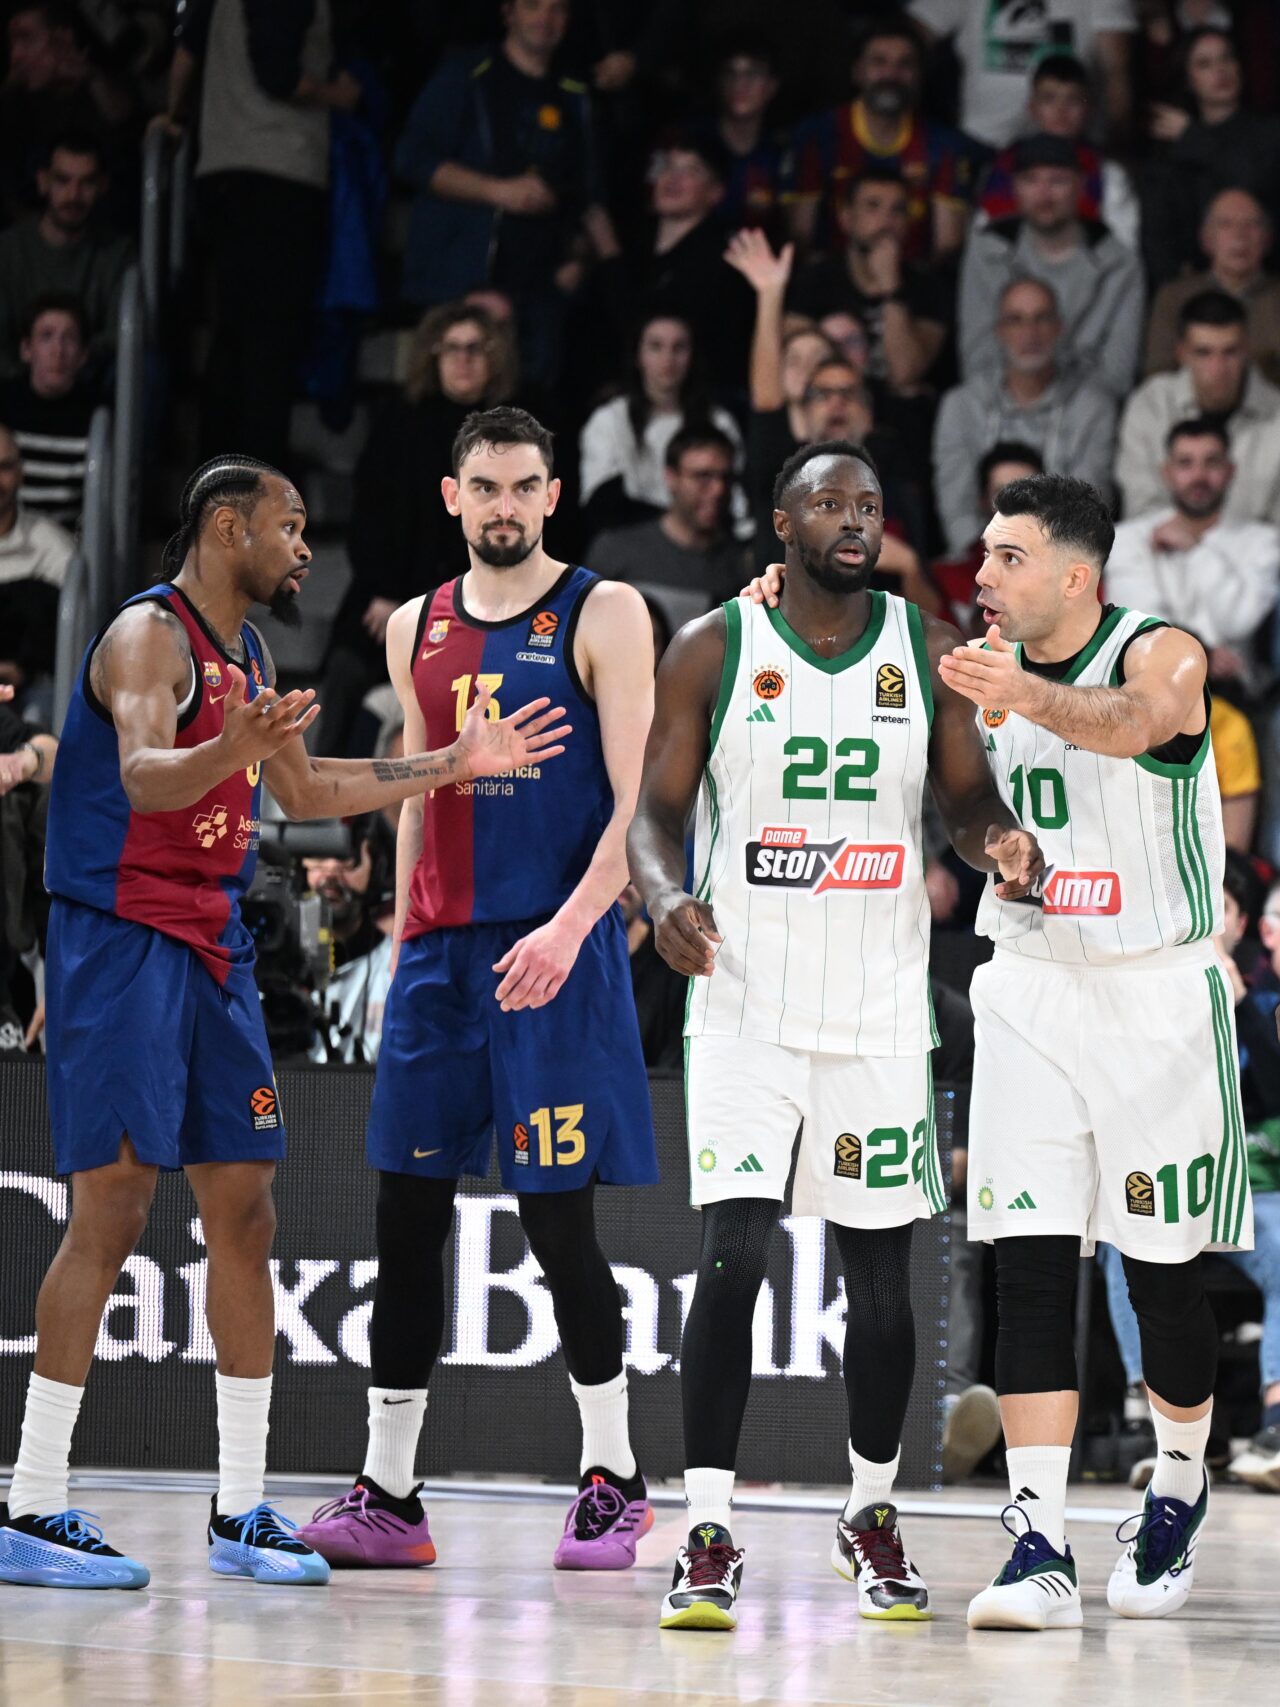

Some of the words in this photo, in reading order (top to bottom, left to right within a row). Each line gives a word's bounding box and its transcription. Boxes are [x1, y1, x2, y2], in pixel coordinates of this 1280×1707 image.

[871, 715, 910, 724] oneteam
[456, 779, 514, 796] Sanitària
[782, 736, 880, 801] 22
[1009, 764, 1069, 830] 10
[765, 830, 802, 844] pame
[530, 1104, 585, 1166] 13
[1156, 1153, 1215, 1224] 10
[0, 1170, 848, 1379] aixBak
